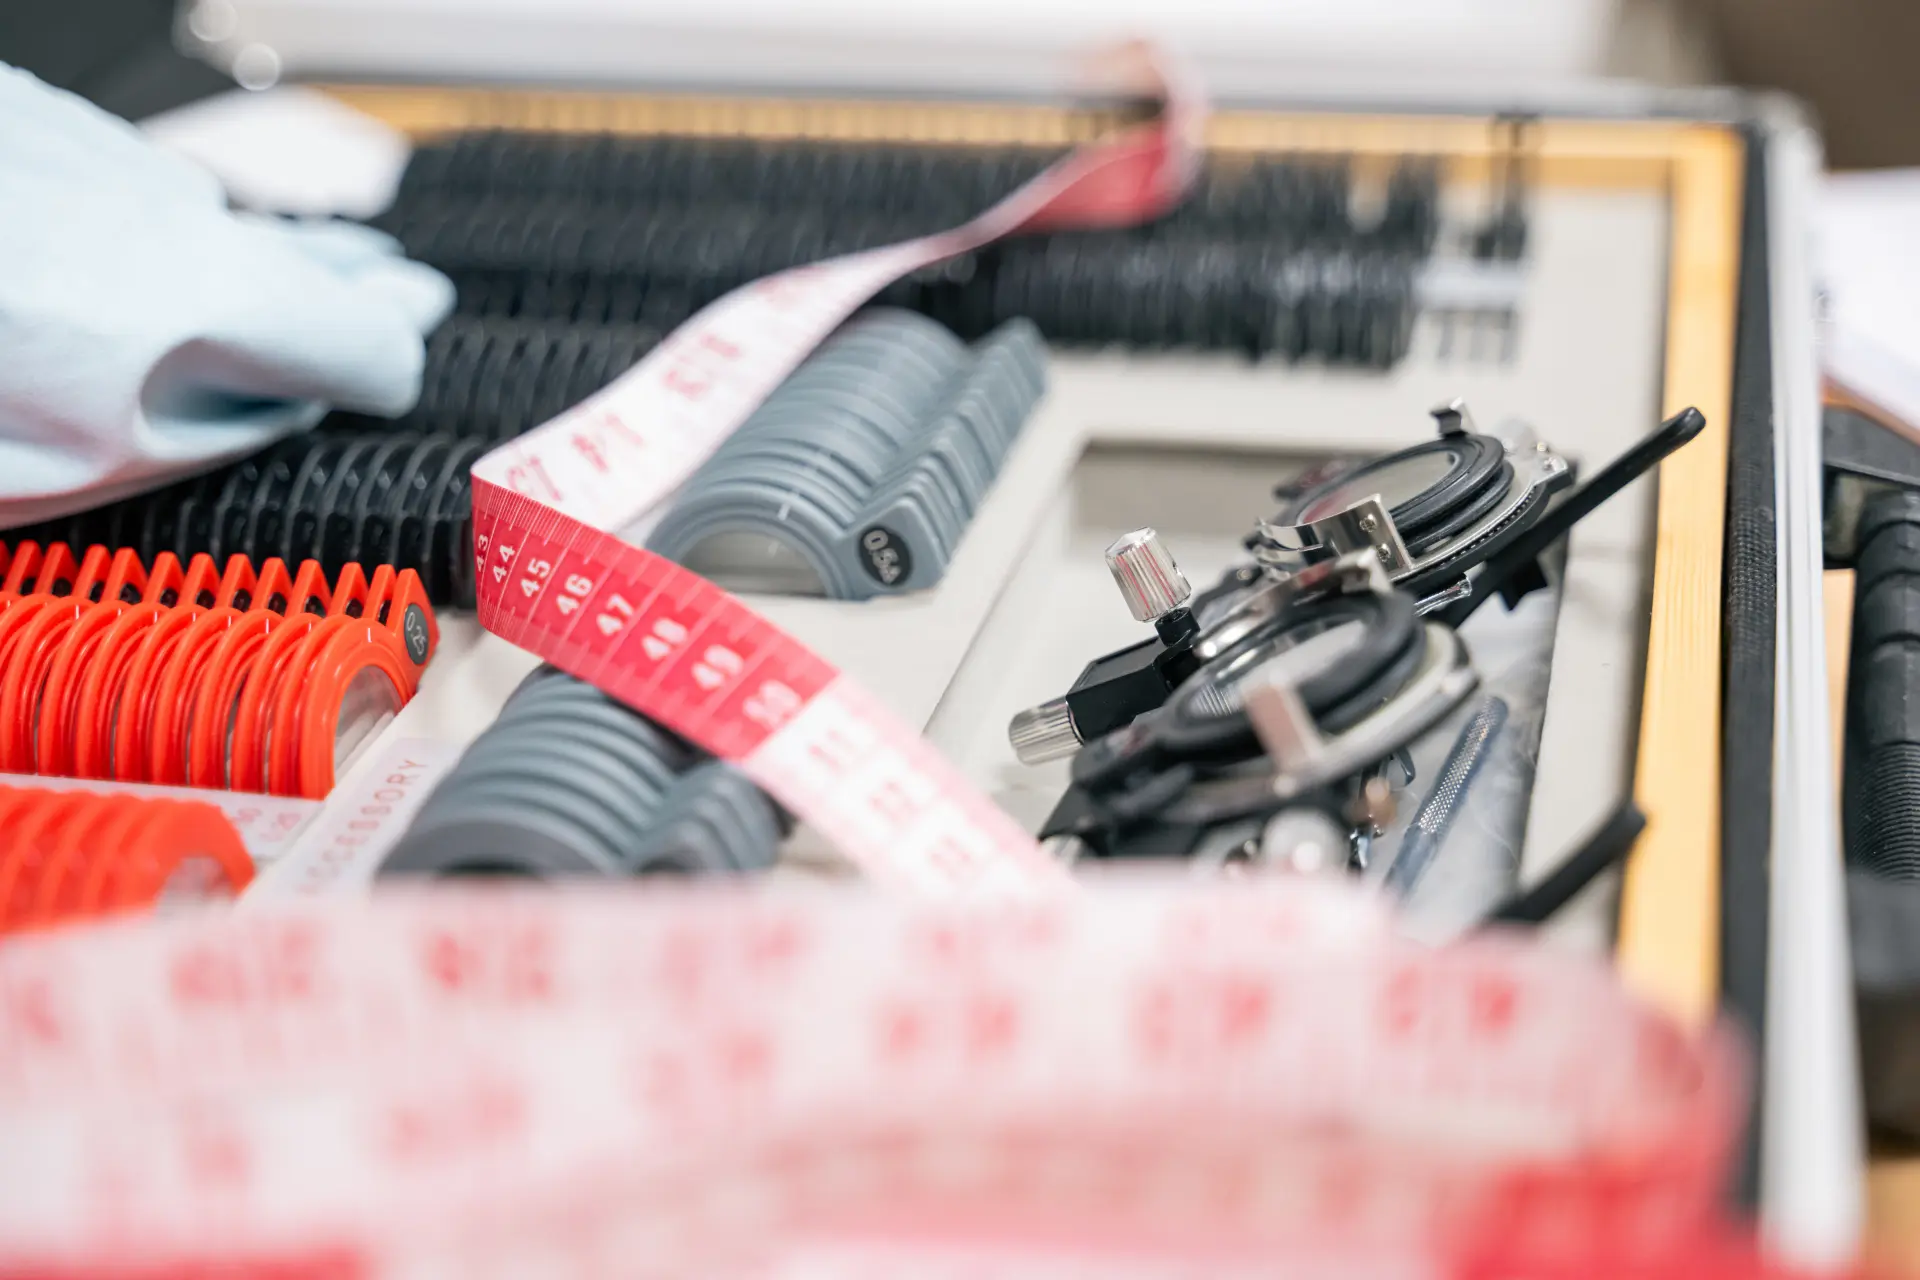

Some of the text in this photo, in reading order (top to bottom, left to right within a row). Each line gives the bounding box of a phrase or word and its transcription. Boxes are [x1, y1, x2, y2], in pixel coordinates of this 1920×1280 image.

[476, 534, 488, 572] 43
[493, 545, 515, 583] 44
[521, 557, 551, 597] 45
[556, 573, 592, 615] 46
[408, 611, 426, 657] 0.25
[596, 594, 634, 636] 47
[692, 644, 743, 690] 49
